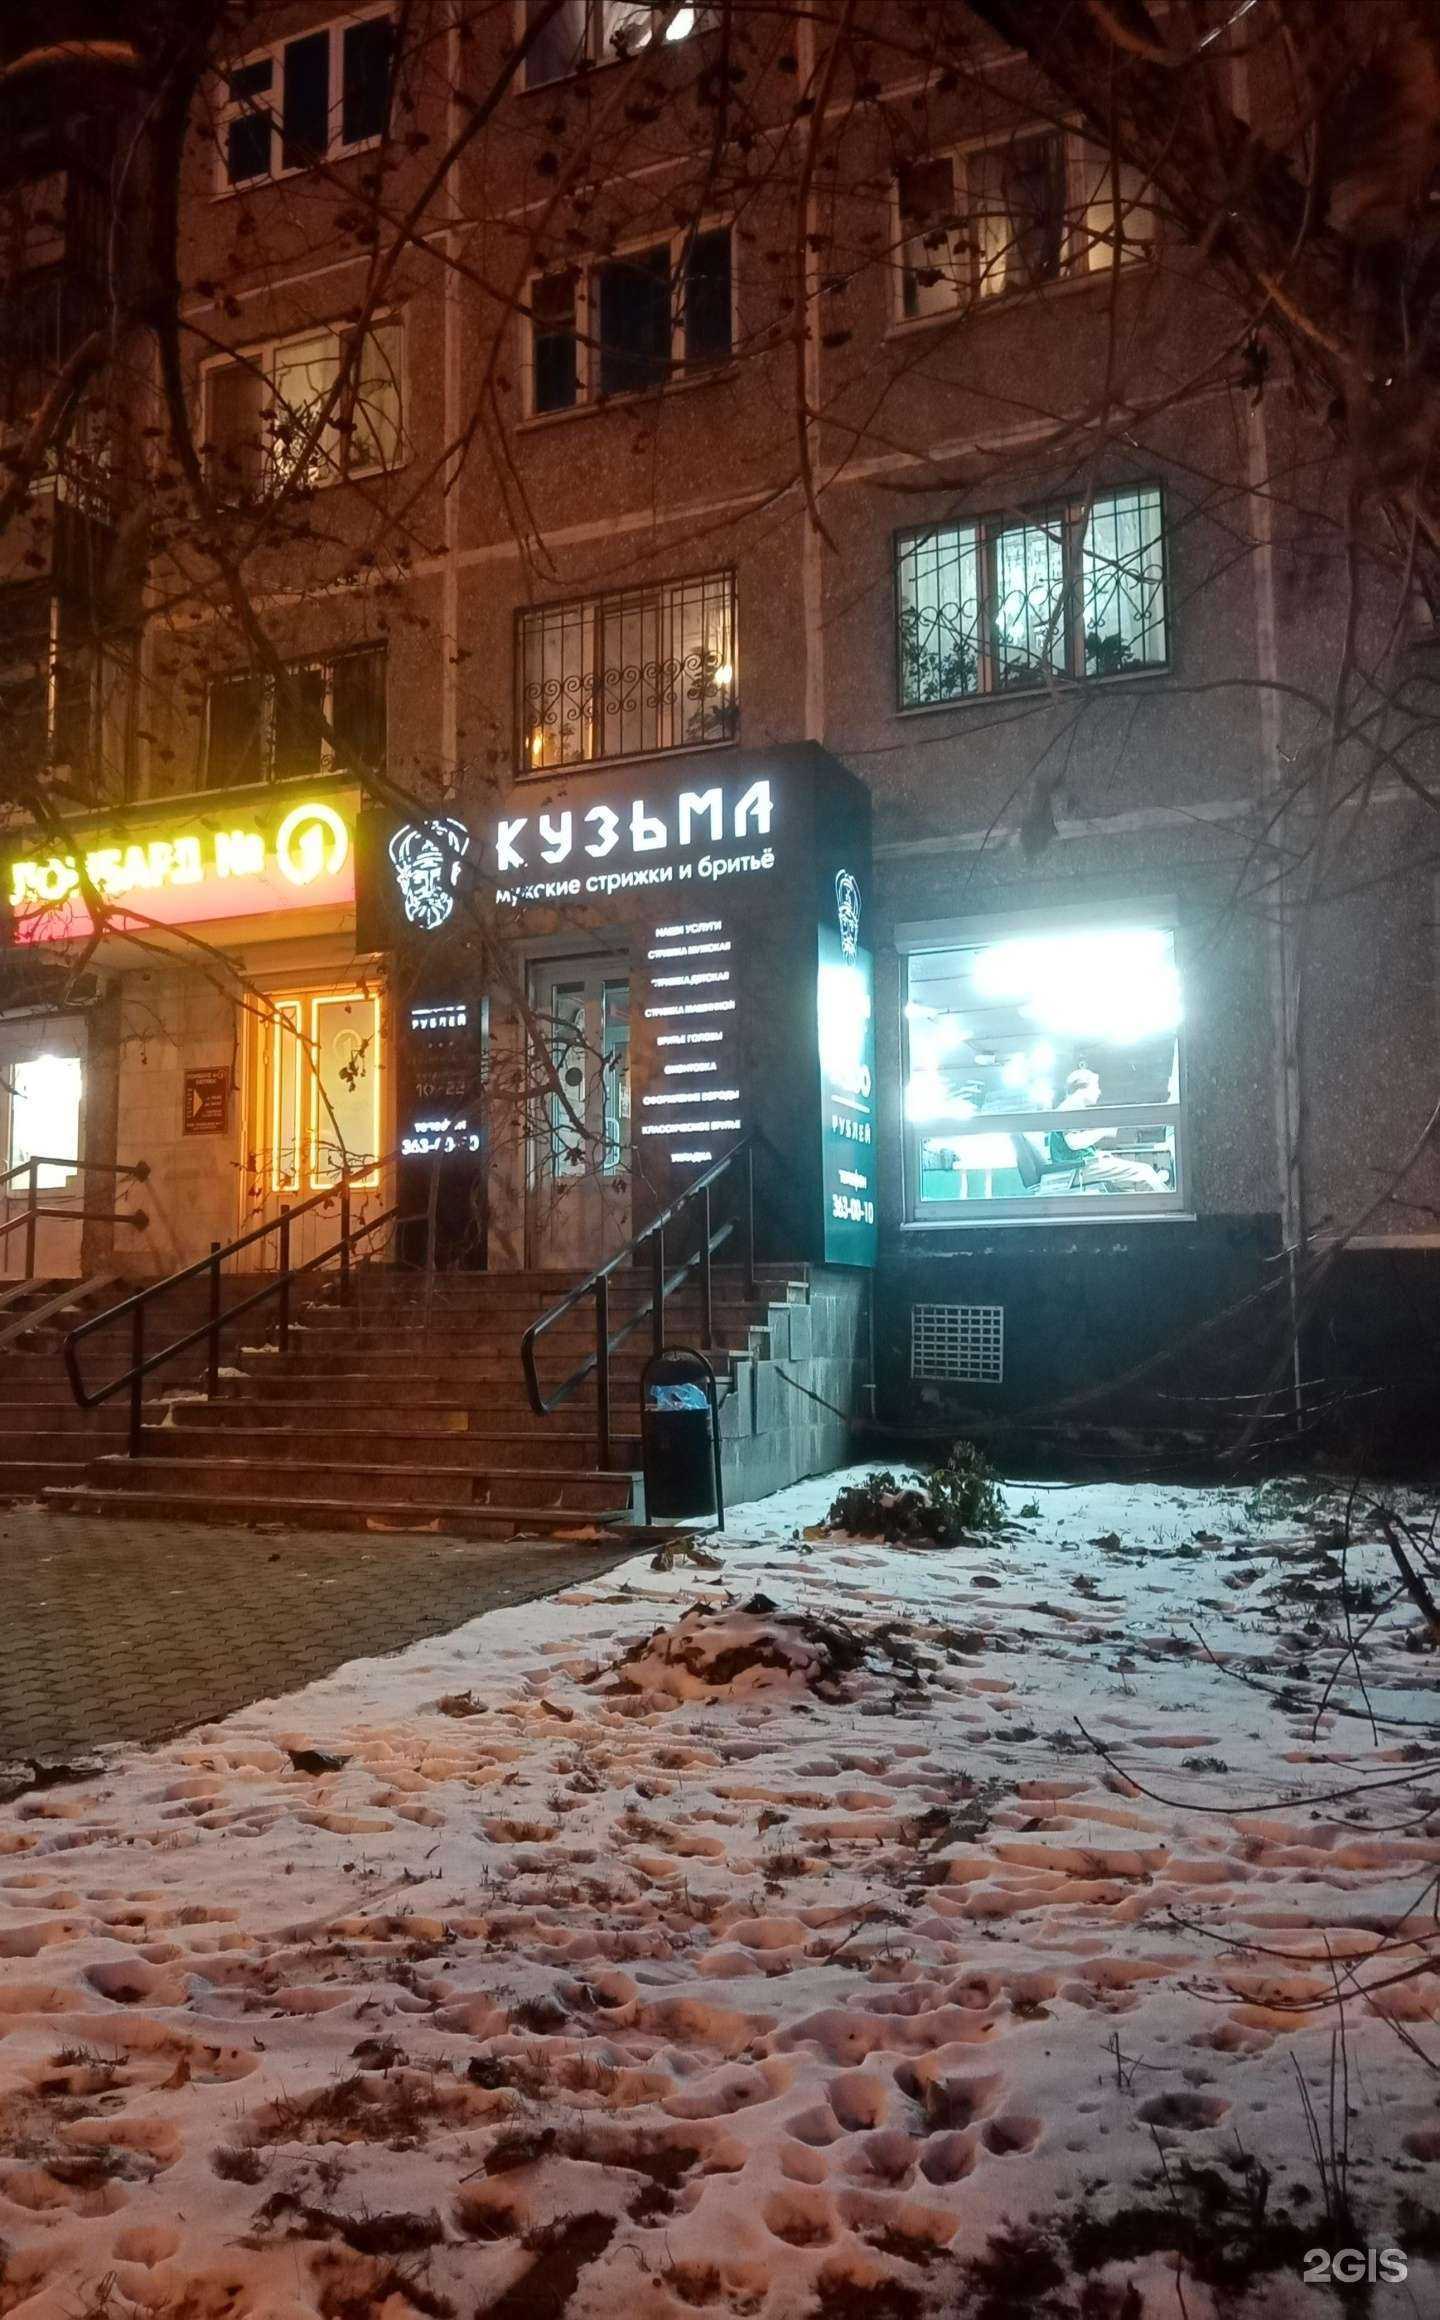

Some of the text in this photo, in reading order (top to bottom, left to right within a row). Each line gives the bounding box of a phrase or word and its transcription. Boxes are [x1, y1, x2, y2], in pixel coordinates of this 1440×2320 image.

[496, 780, 773, 871] КУЗЬМА
[586, 866, 673, 895] стрижки
[679, 864, 692, 880] и
[698, 848, 775, 881] бритьё
[832, 1114, 871, 1144] РУБЛЕЙ
